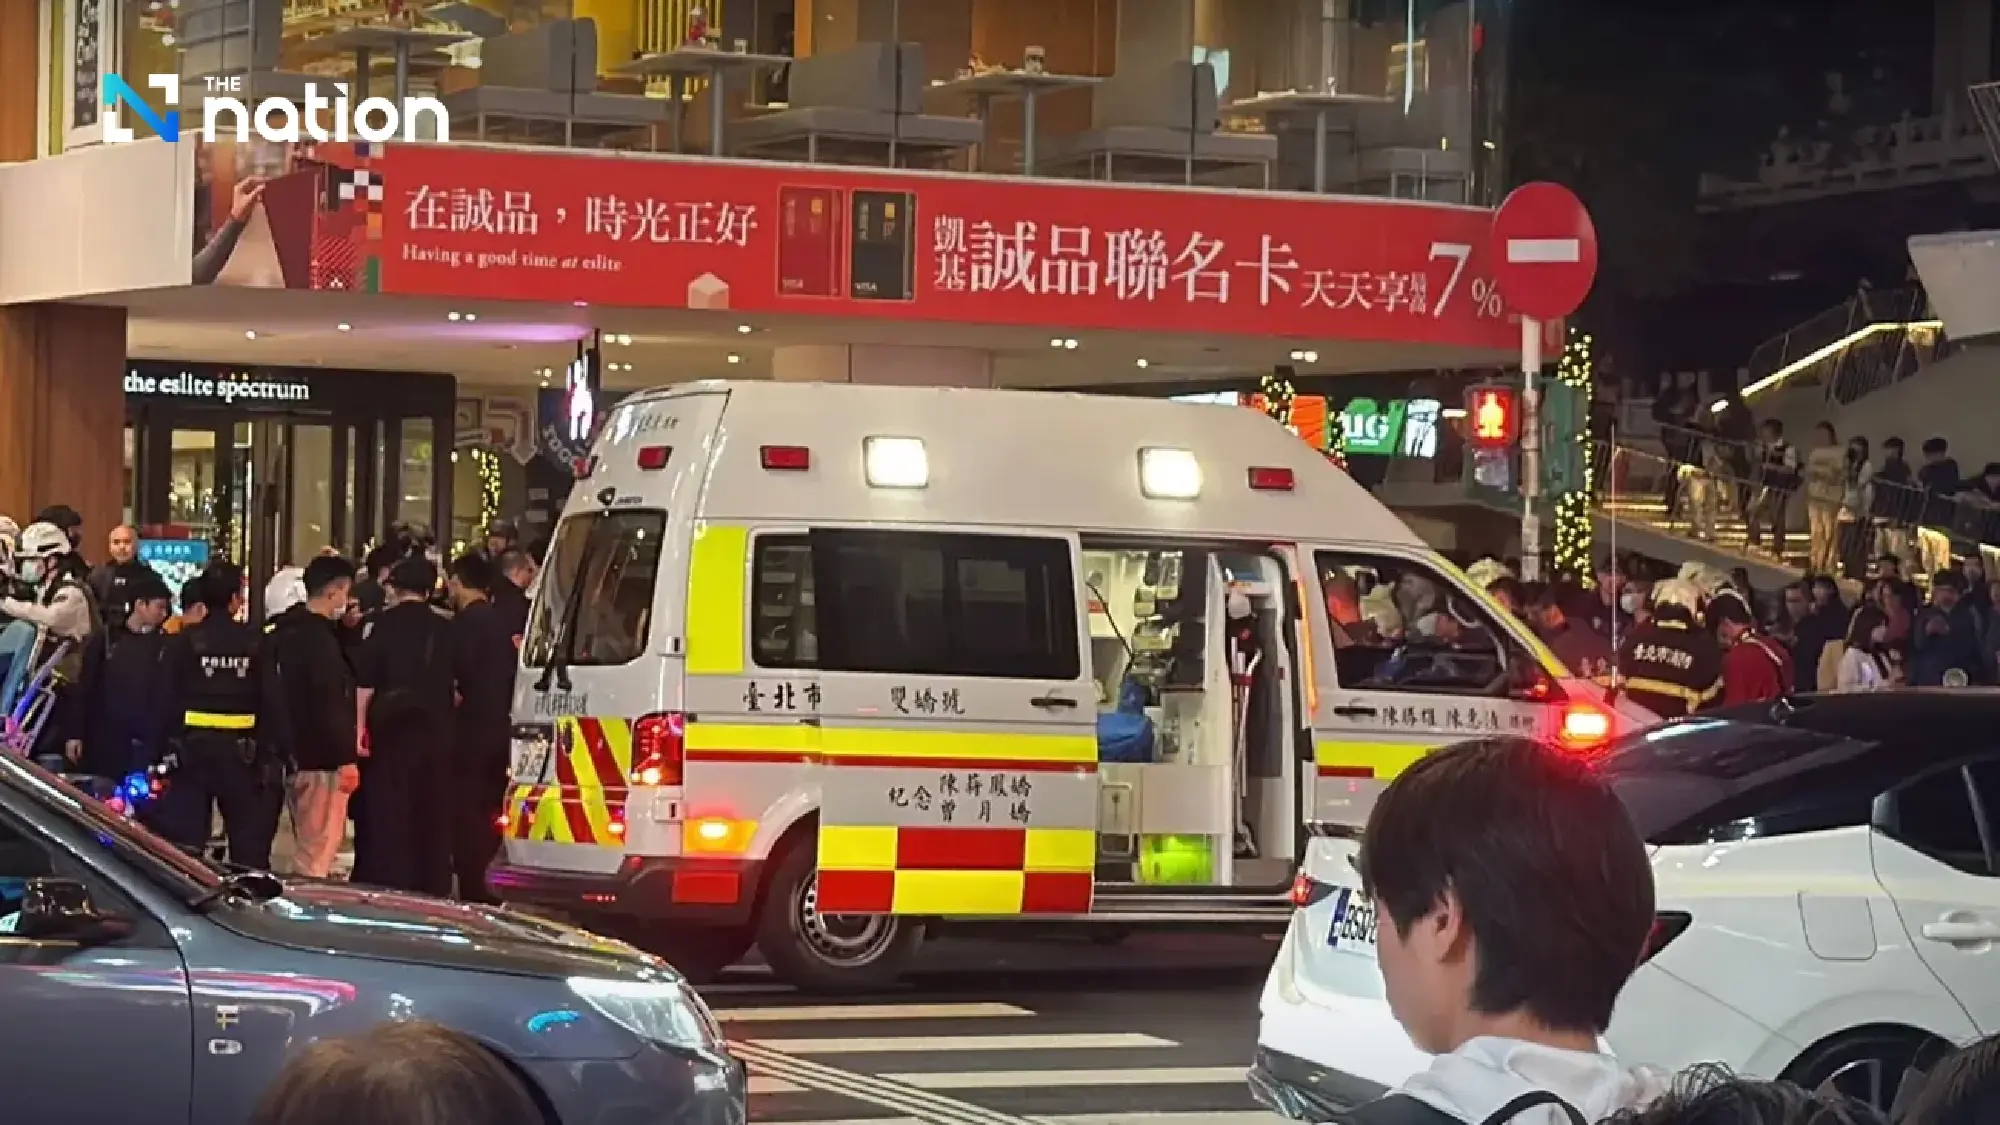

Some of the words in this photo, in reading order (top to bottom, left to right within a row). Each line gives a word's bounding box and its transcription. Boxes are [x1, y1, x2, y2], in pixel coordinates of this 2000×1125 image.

[402, 243, 460, 268] Having
[465, 252, 473, 264] a
[478, 248, 517, 269] good
[522, 249, 556, 268] time
[562, 255, 578, 269] at
[583, 253, 622, 272] eslite
[968, 219, 1299, 306] 誠品聯名卡
[1301, 269, 1409, 313] 天天享
[123, 368, 156, 393] the
[159, 371, 214, 396] eslite
[217, 377, 310, 404] spectrum
[201, 656, 250, 669] POLICE
[742, 681, 821, 711] 臺北市
[888, 785, 932, 810] 紀念
